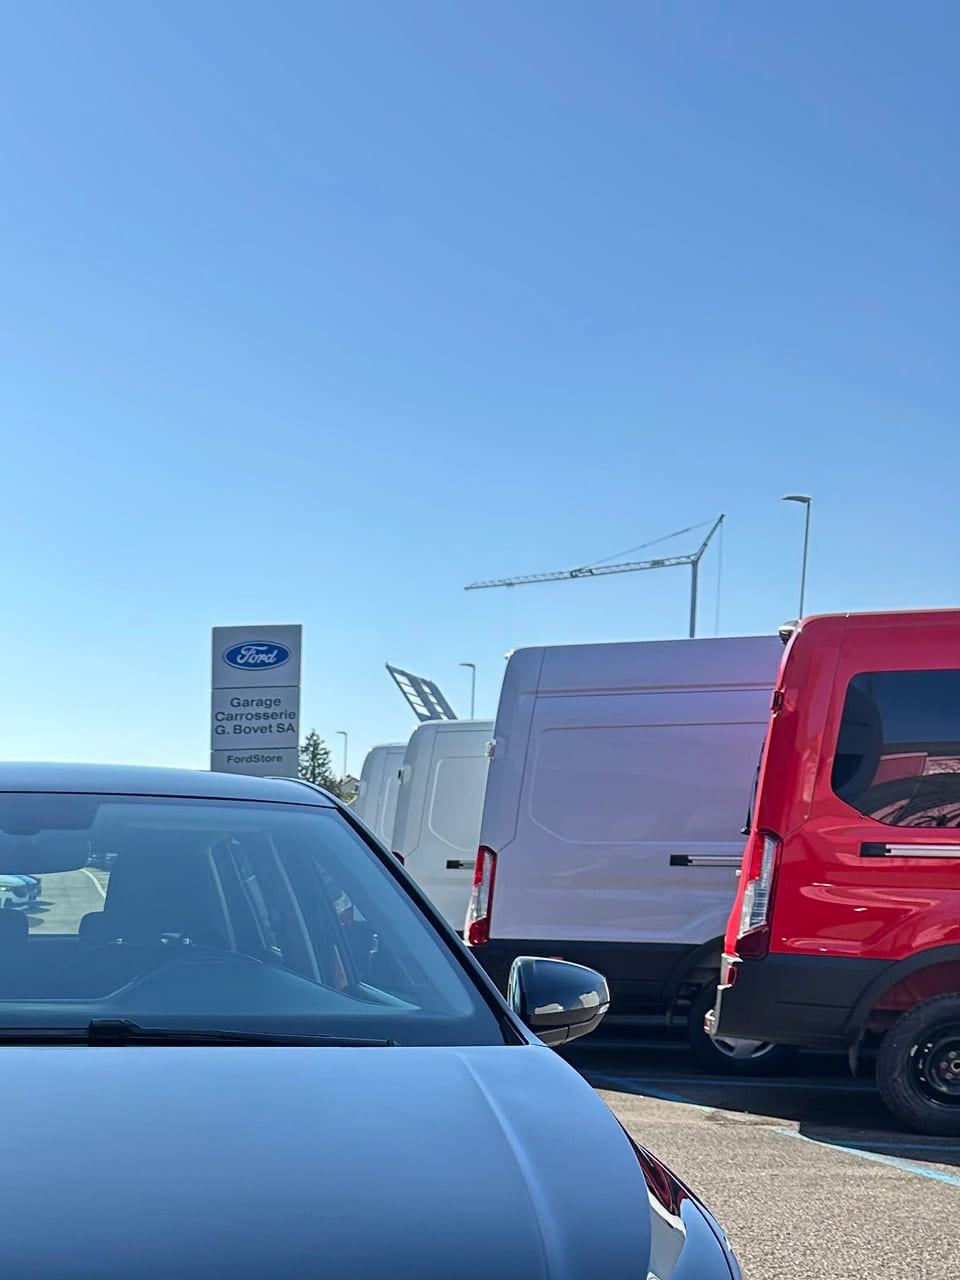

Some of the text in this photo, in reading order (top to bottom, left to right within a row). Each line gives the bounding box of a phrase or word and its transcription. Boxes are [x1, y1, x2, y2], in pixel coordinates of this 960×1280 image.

[236, 645, 278, 665] Ford
[230, 697, 282, 709] Garage
[214, 709, 297, 722] Carrosserie
[214, 722, 296, 736] G. Bovet SA
[226, 754, 283, 764] FordStore
